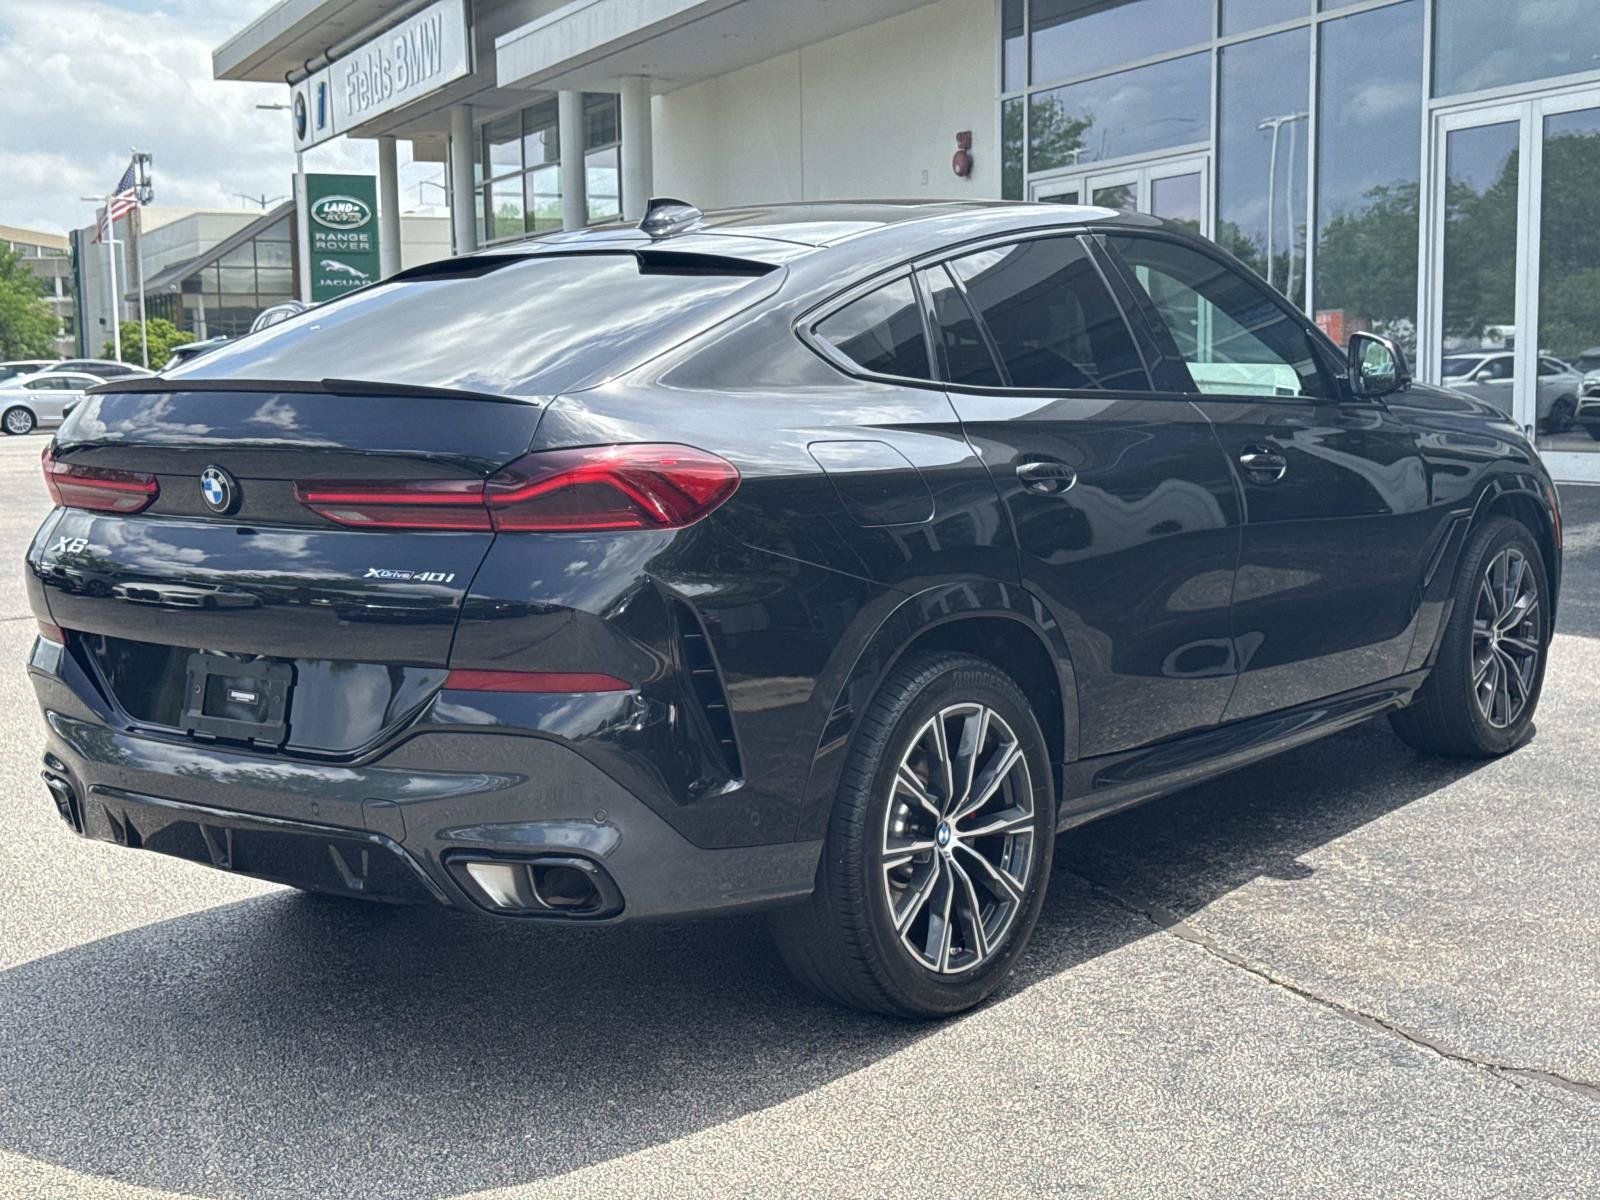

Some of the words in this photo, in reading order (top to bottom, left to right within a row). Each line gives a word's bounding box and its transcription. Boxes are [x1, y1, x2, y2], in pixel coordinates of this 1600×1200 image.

[346, 48, 393, 117] Fields
[393, 13, 443, 93] BMW
[323, 202, 353, 213] LAND
[315, 233, 368, 242] RANGE
[316, 242, 370, 250] ROVER
[50, 536, 89, 553] X6
